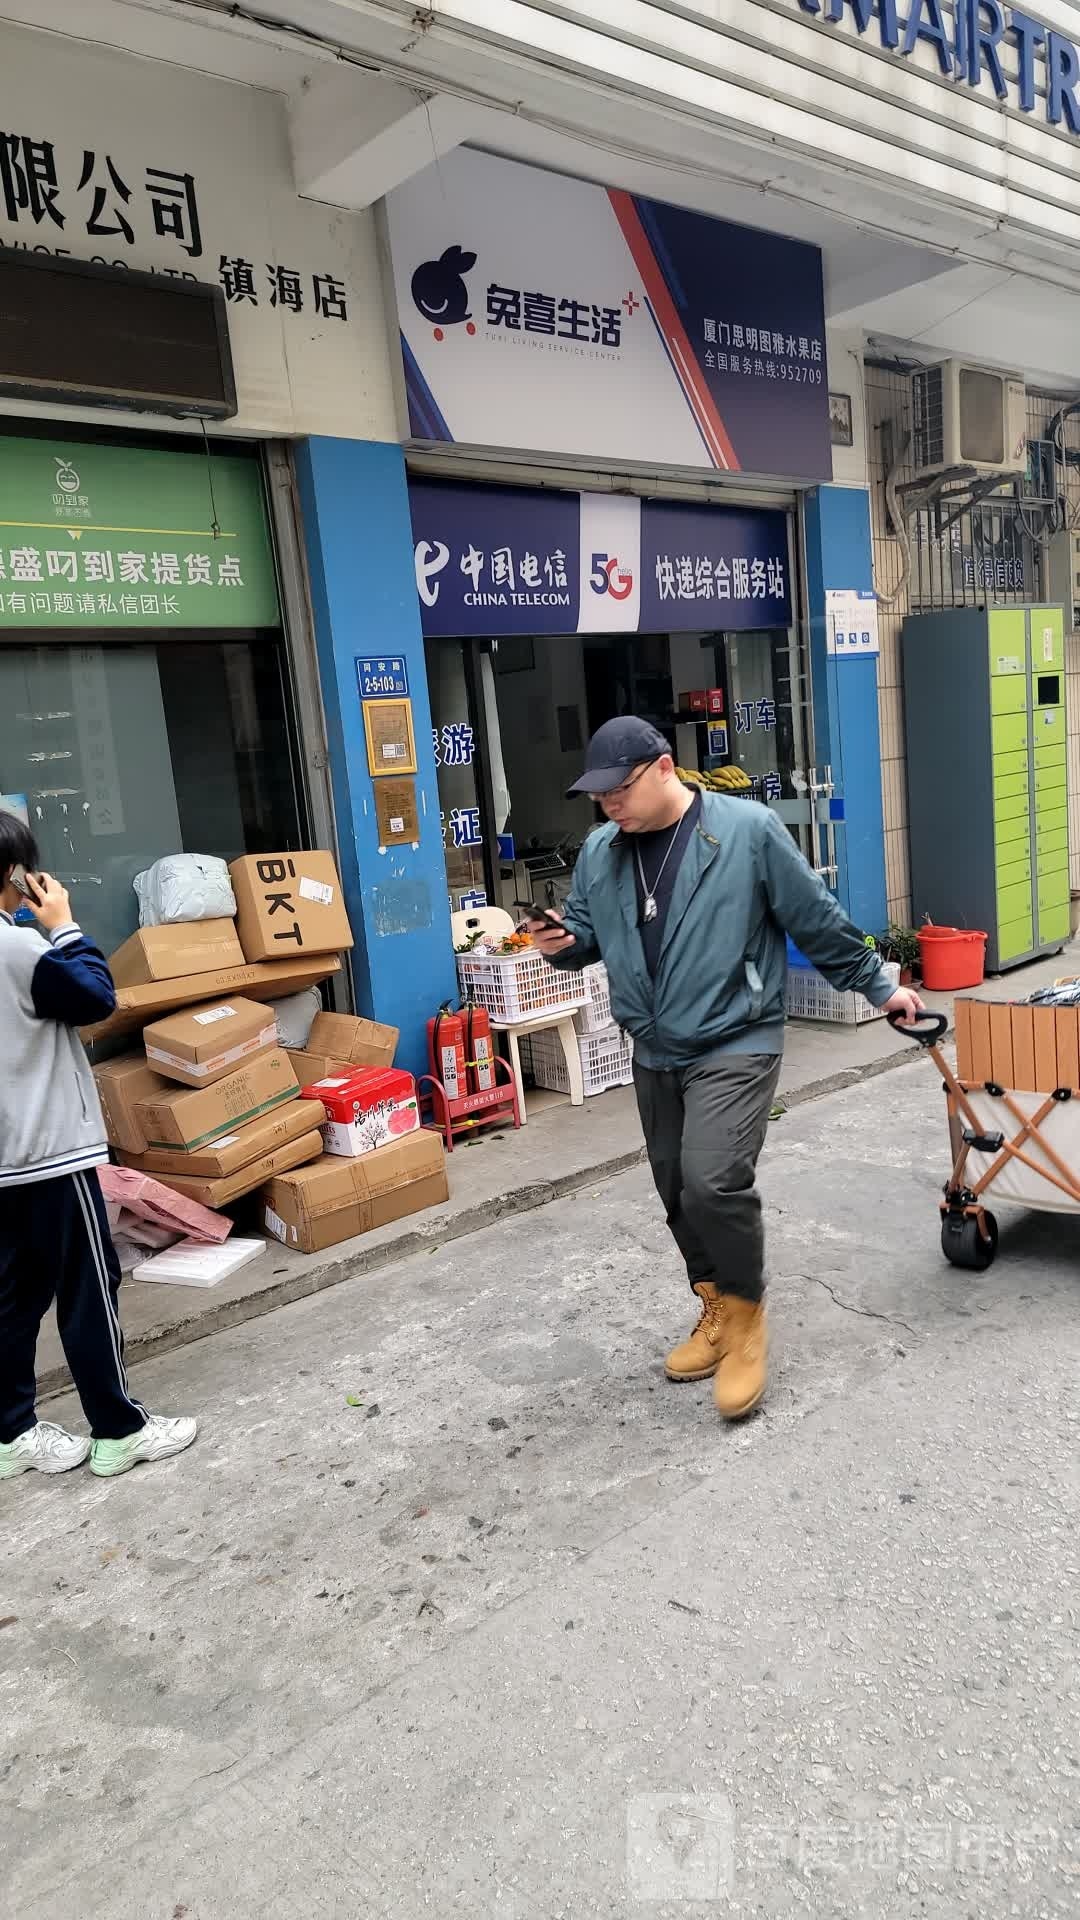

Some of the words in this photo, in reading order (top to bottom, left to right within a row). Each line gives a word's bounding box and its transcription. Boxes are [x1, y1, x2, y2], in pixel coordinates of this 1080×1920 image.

[0, 131, 203, 257] 限公司
[219, 255, 348, 321] 镇海店
[548, 343, 585, 356] SERVICE
[703, 318, 822, 361] 厦门思明图雅水果店
[0, 546, 244, 586] 盛叨到家提货点
[460, 543, 569, 592] 中国电信
[590, 553, 633, 600] 5G
[655, 554, 784, 600] 快递综合服务站
[0, 591, 181, 615] 有问题请私信团长
[463, 592, 507, 606] CHINA
[510, 592, 570, 606] TELECOM
[734, 697, 777, 734] 订车
[440, 807, 482, 849] 证
[215, 1072, 251, 1096] ORGANIC
